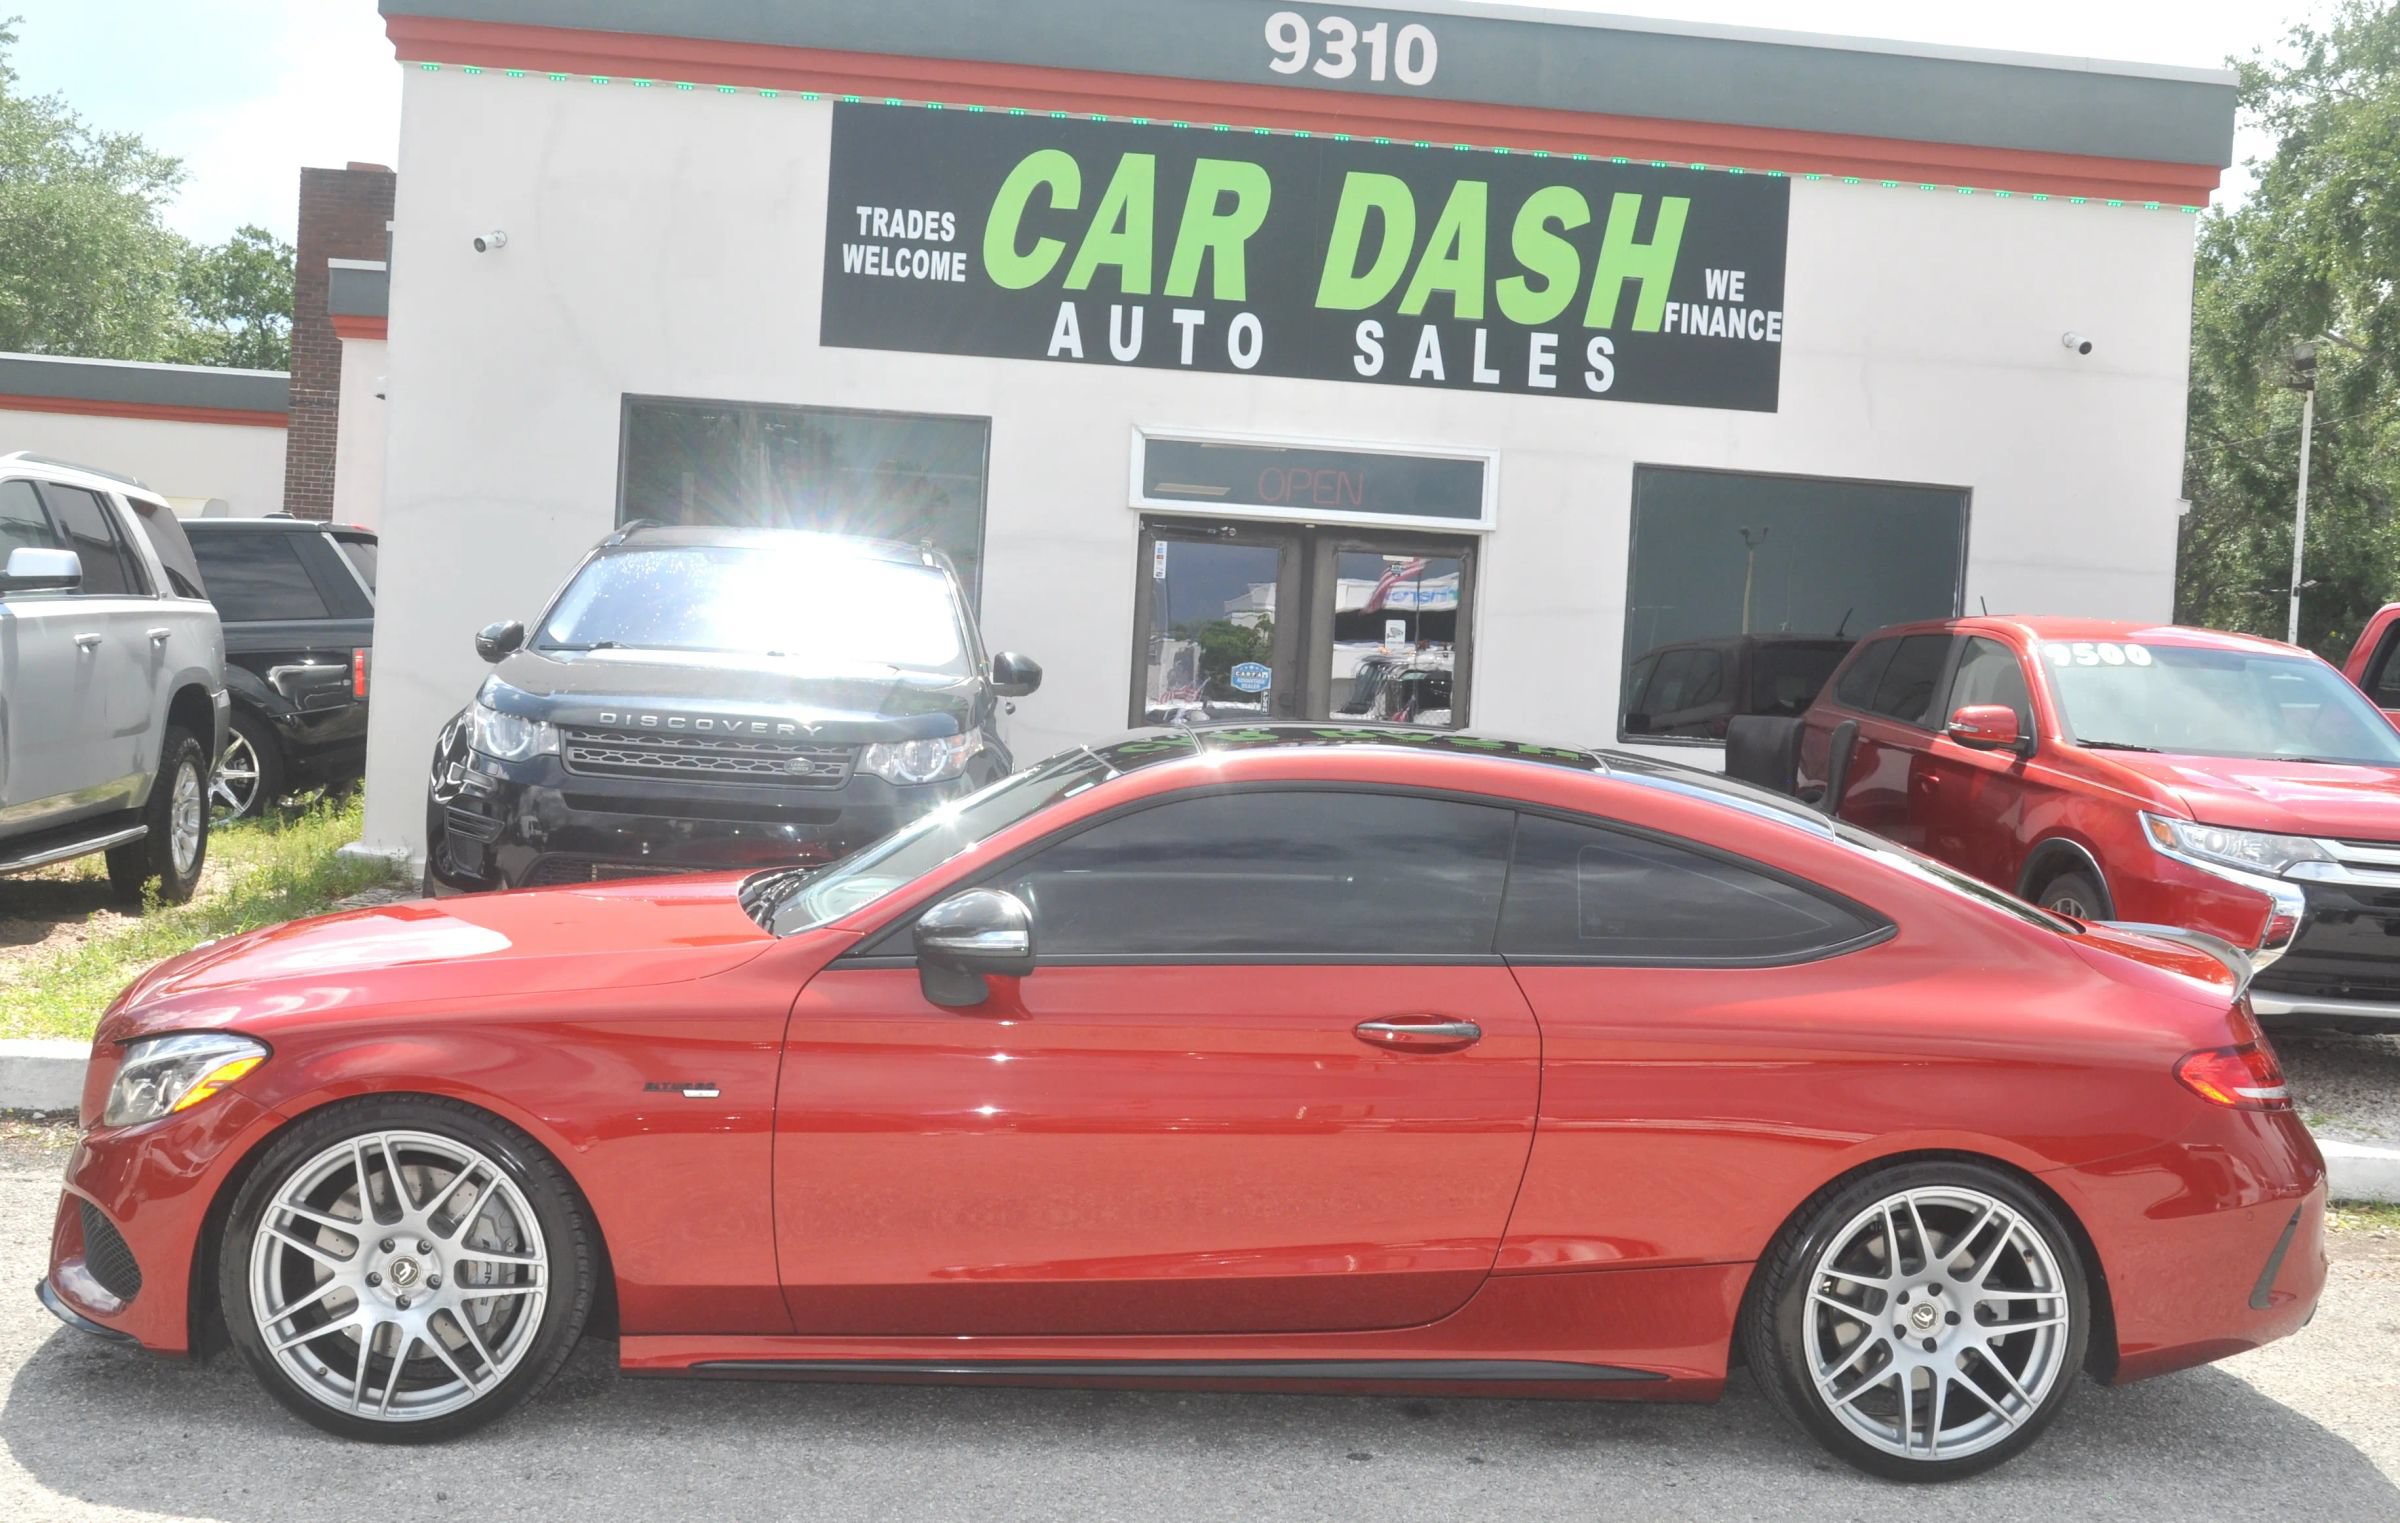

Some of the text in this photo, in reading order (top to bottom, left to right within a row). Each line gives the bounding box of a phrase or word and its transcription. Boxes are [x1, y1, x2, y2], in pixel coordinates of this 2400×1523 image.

[1265, 11, 1438, 86] 9310
[856, 205, 956, 242] TRADES
[983, 149, 1691, 332] CAR DASH
[842, 244, 967, 282] WELCOME
[1705, 269, 1746, 302] WE
[1664, 301, 1783, 342] FINANCE
[1047, 301, 1615, 392] AUTO SALES
[1258, 467, 1364, 505] OPEN
[599, 712, 823, 737] DISCOVERY
